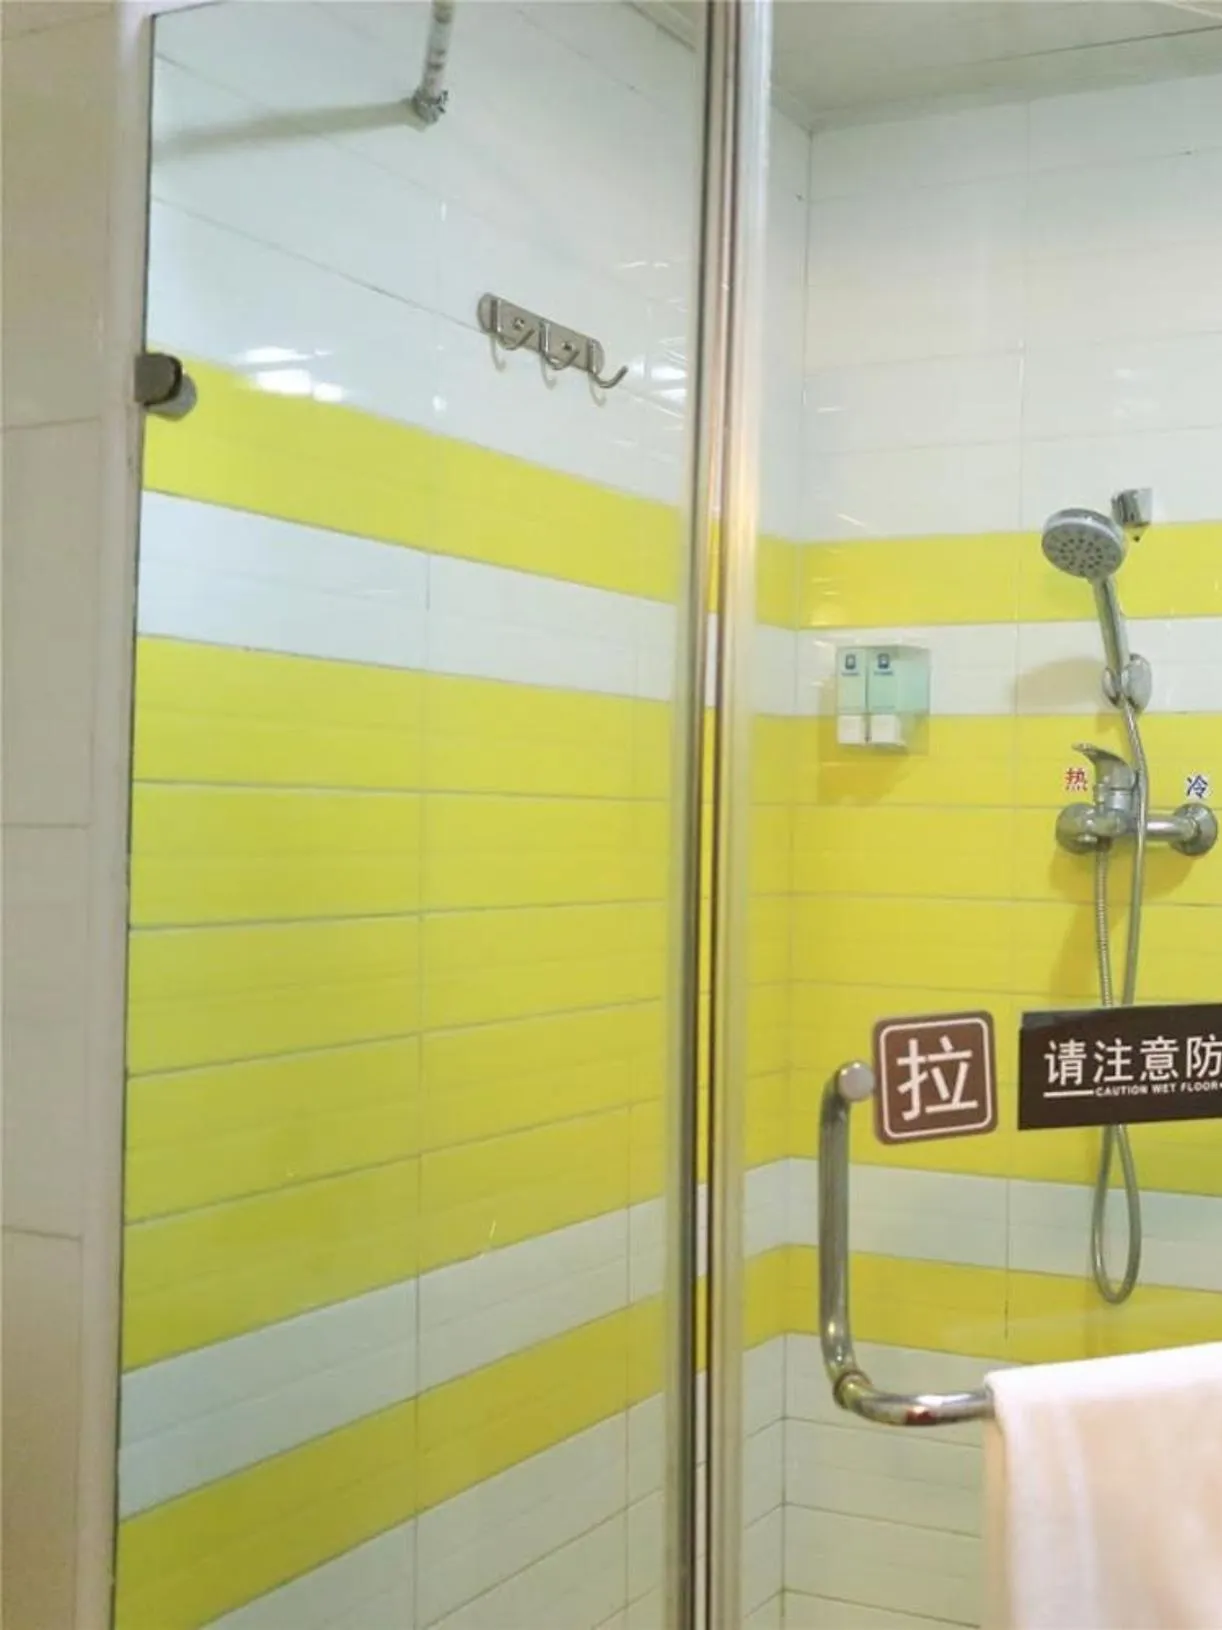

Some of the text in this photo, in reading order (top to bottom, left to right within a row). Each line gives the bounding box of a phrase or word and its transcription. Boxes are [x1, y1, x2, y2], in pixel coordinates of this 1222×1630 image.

[1065, 767, 1088, 791] 热
[1186, 774, 1209, 798] 冷
[896, 1034, 979, 1121] 拉
[1095, 1080, 1219, 1097] CAUTION WET FLOOR
